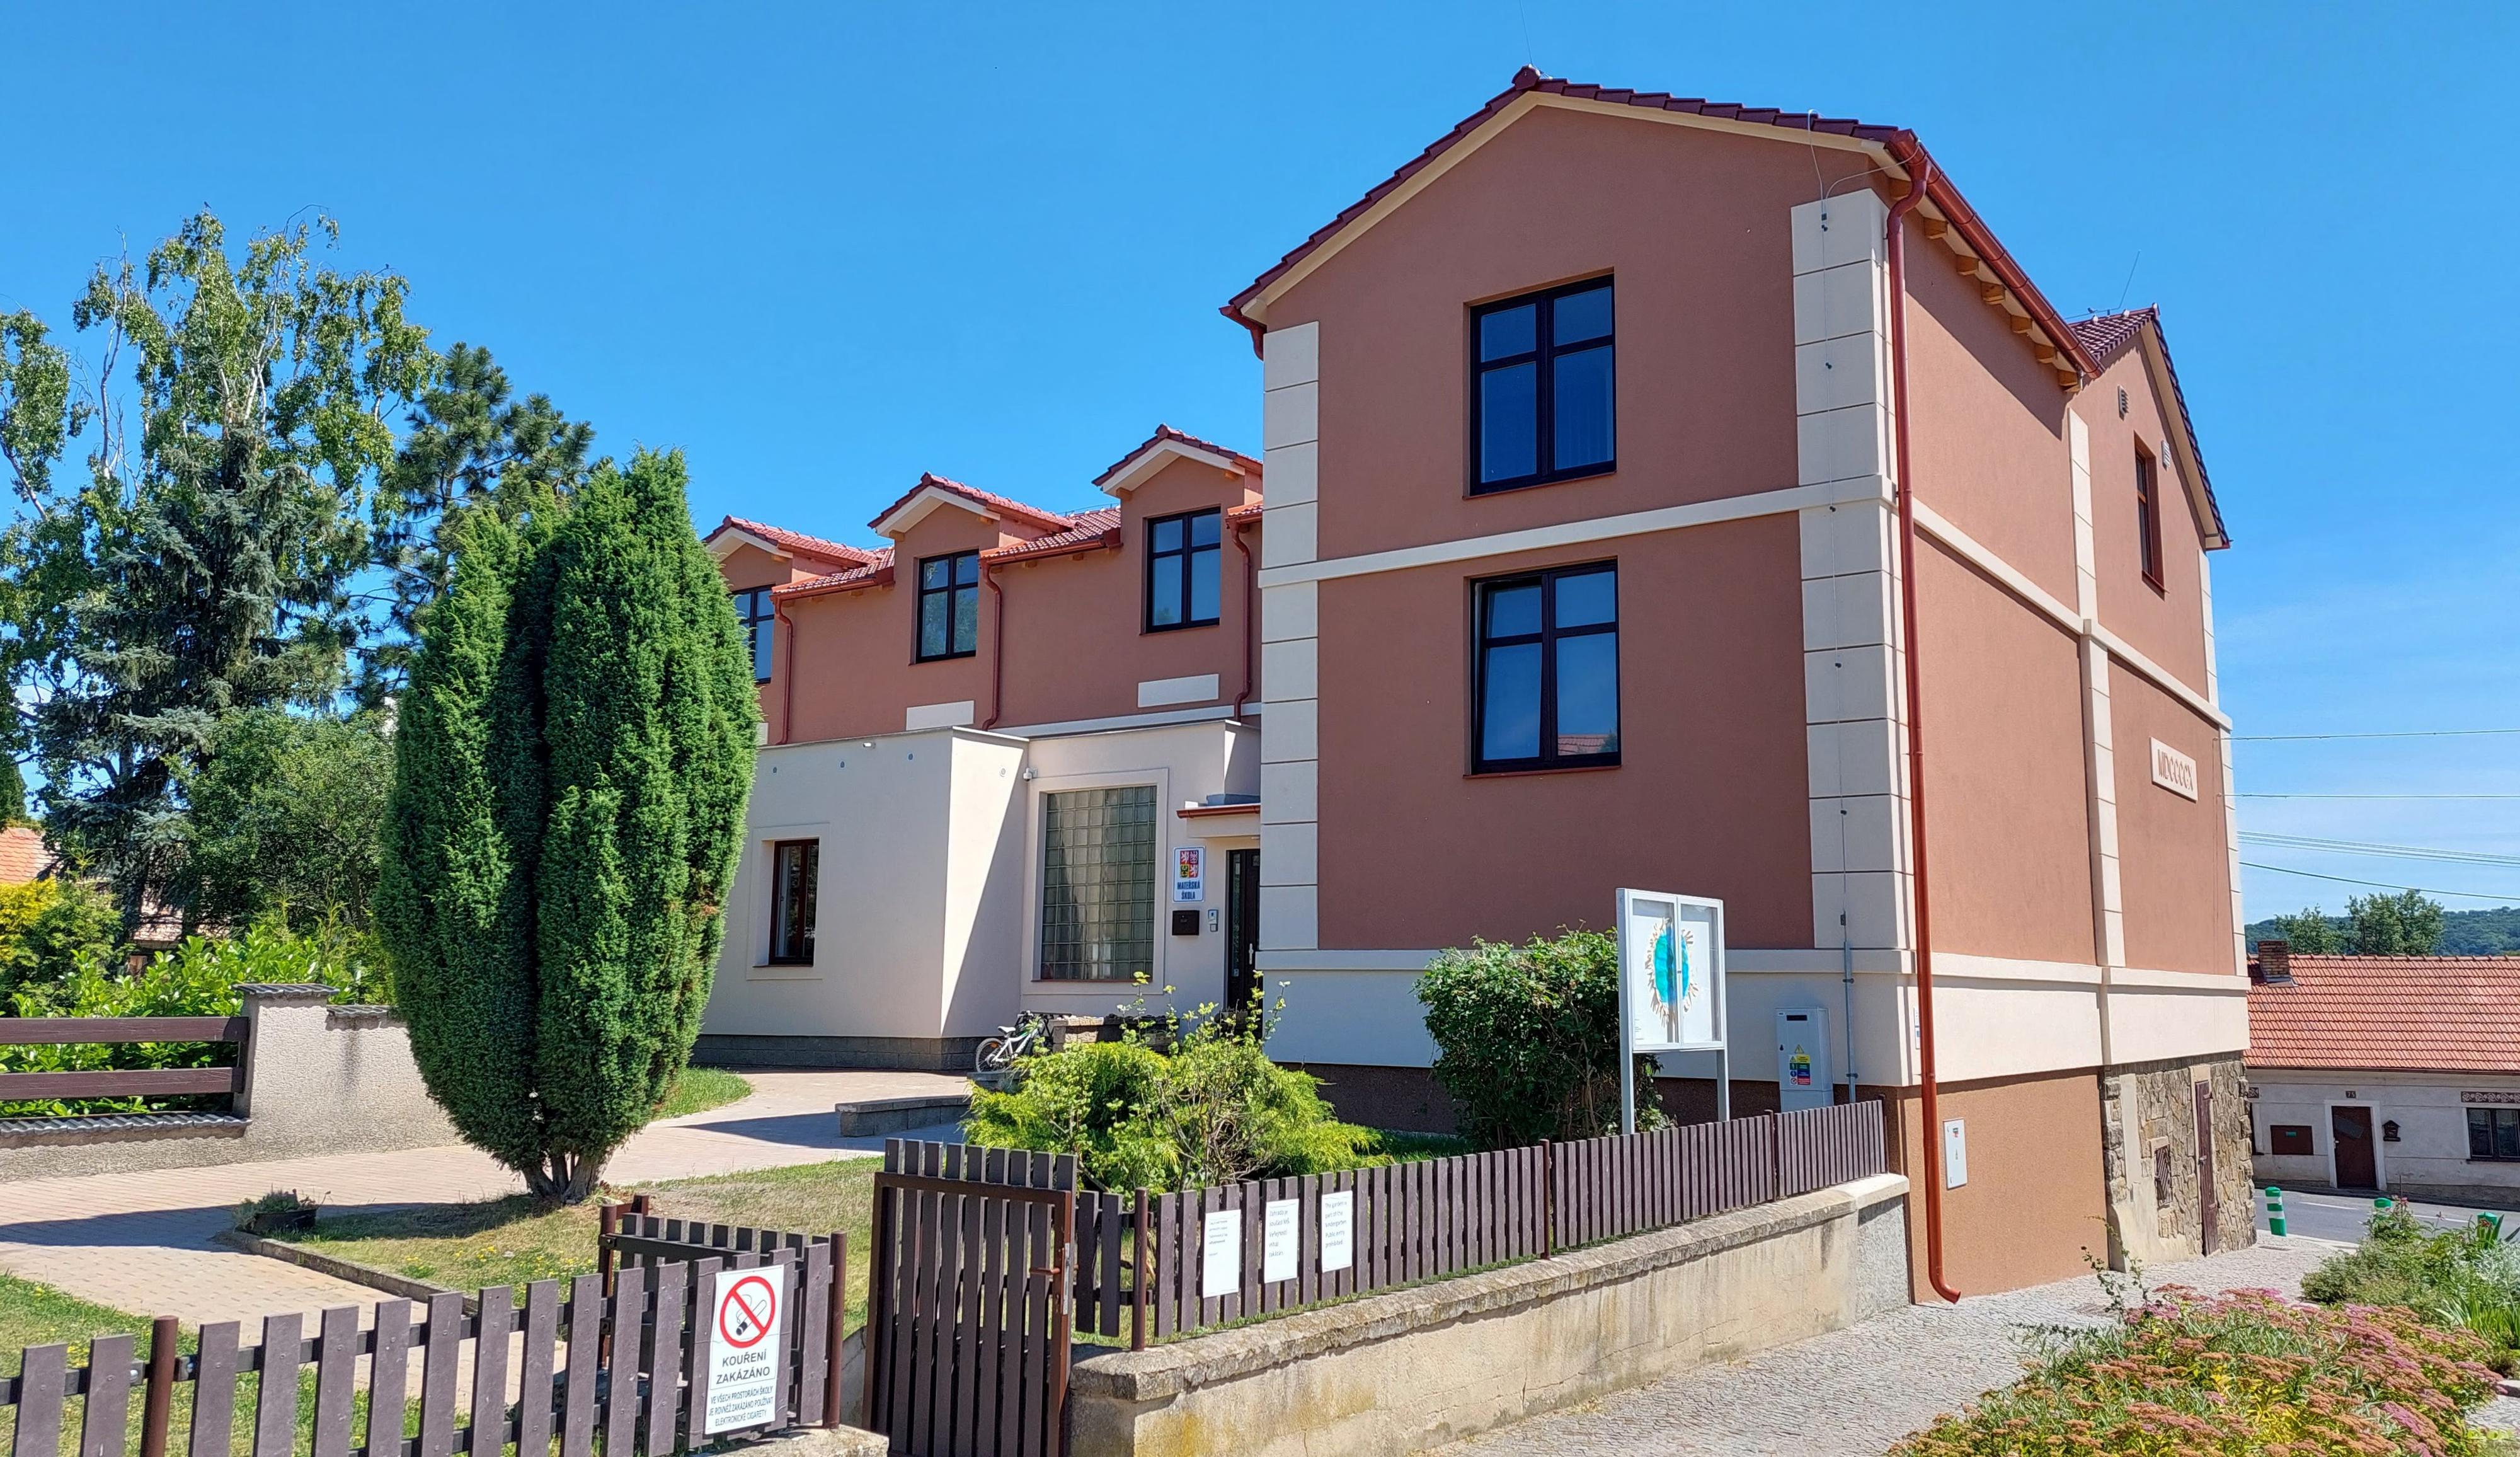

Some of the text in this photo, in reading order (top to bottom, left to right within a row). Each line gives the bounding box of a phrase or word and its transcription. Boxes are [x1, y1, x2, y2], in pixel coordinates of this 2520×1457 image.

[1177, 880, 1200, 890] MATEŘSKÁ
[1181, 890, 1196, 900] ŠKOLA
[722, 1348, 767, 1368] KOUŘENÍ
[716, 1366, 770, 1385] ZAKÁZÁNO
[711, 1385, 774, 1405] VE VŠECH PROSTORÁCH ŠKOLY
[708, 1395, 774, 1417] JE ROVNĚŽ ZAKÁZÁNO POUŽÍVAT
[715, 1408, 767, 1427] ELEKTRONICKÉ CIGARETY
